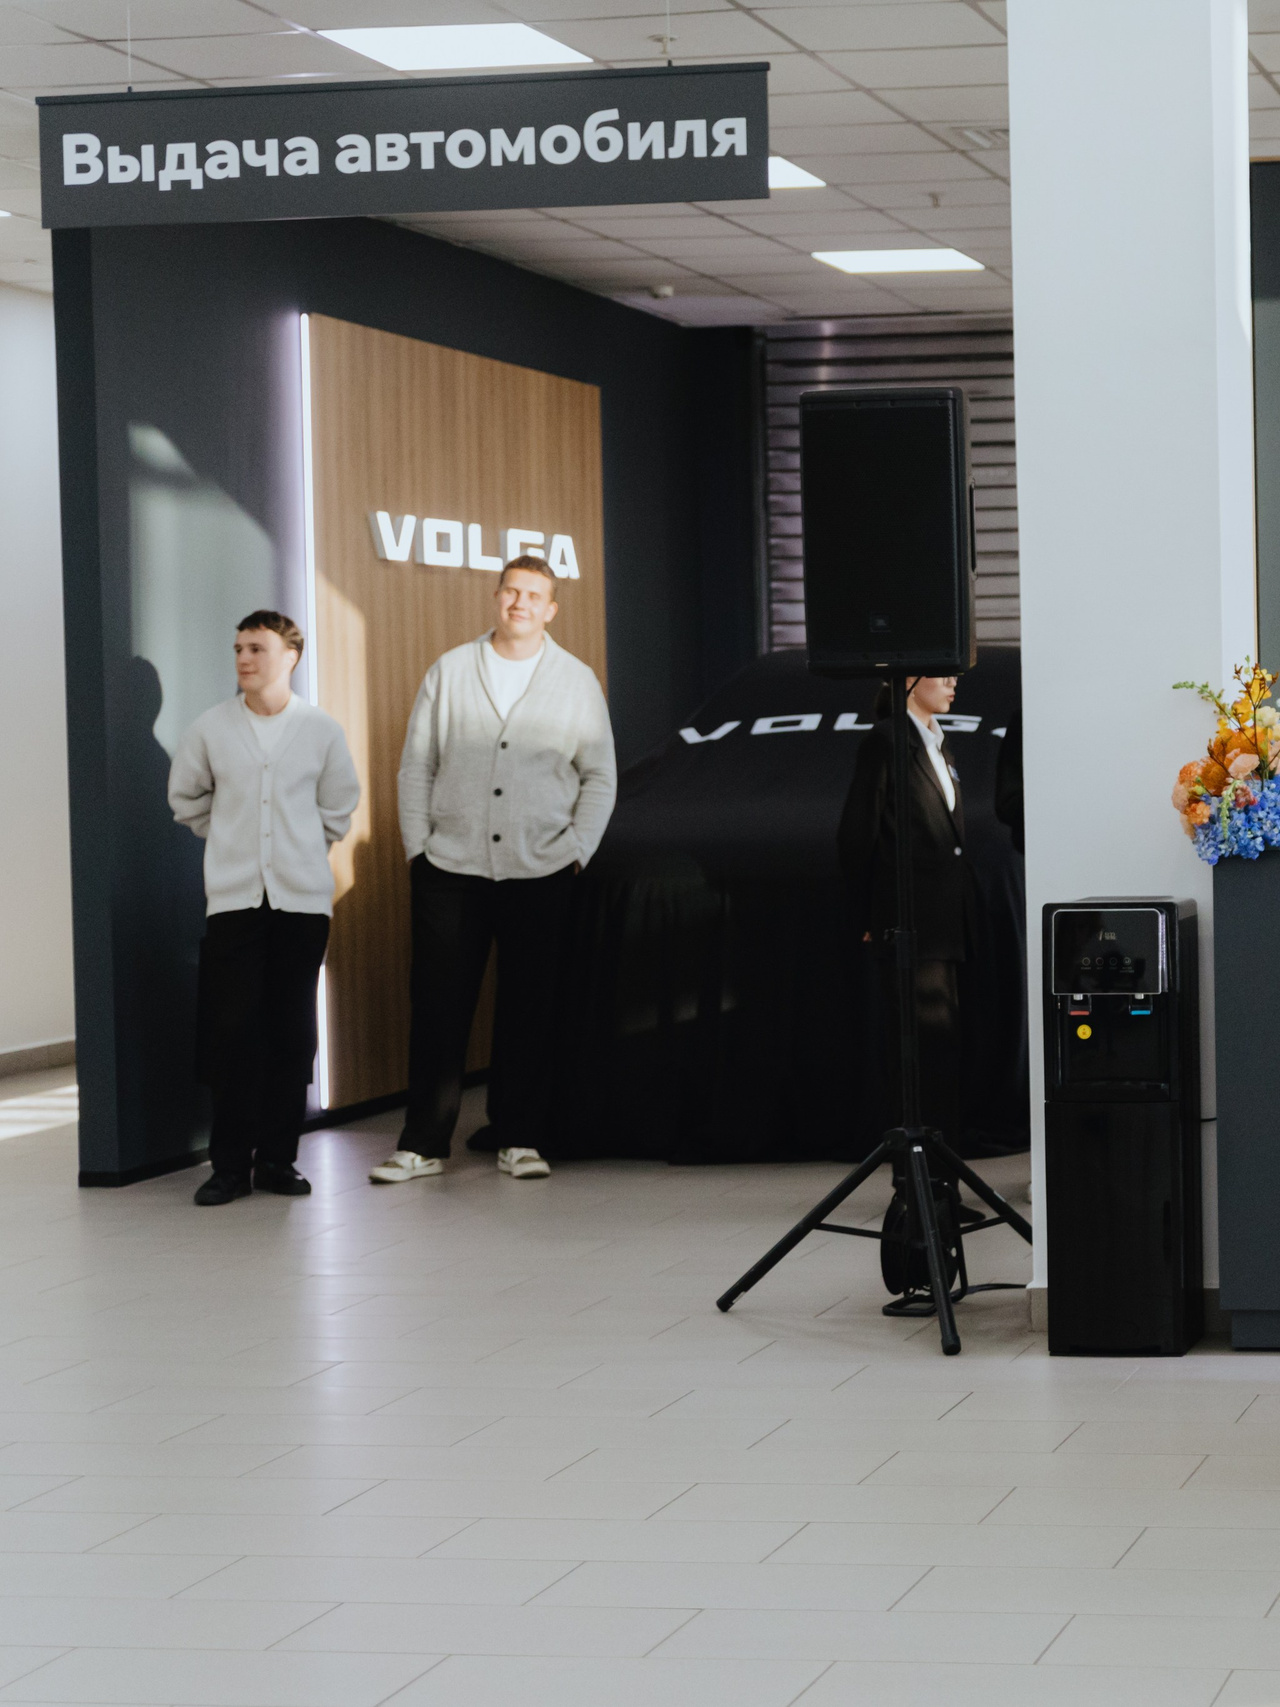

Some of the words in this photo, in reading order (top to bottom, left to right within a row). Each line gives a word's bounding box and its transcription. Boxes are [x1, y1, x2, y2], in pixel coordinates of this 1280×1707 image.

[62, 132, 320, 192] Выдача
[334, 108, 748, 174] автомобиля
[375, 510, 581, 580] VOLGA
[678, 712, 1008, 745] VOLG
